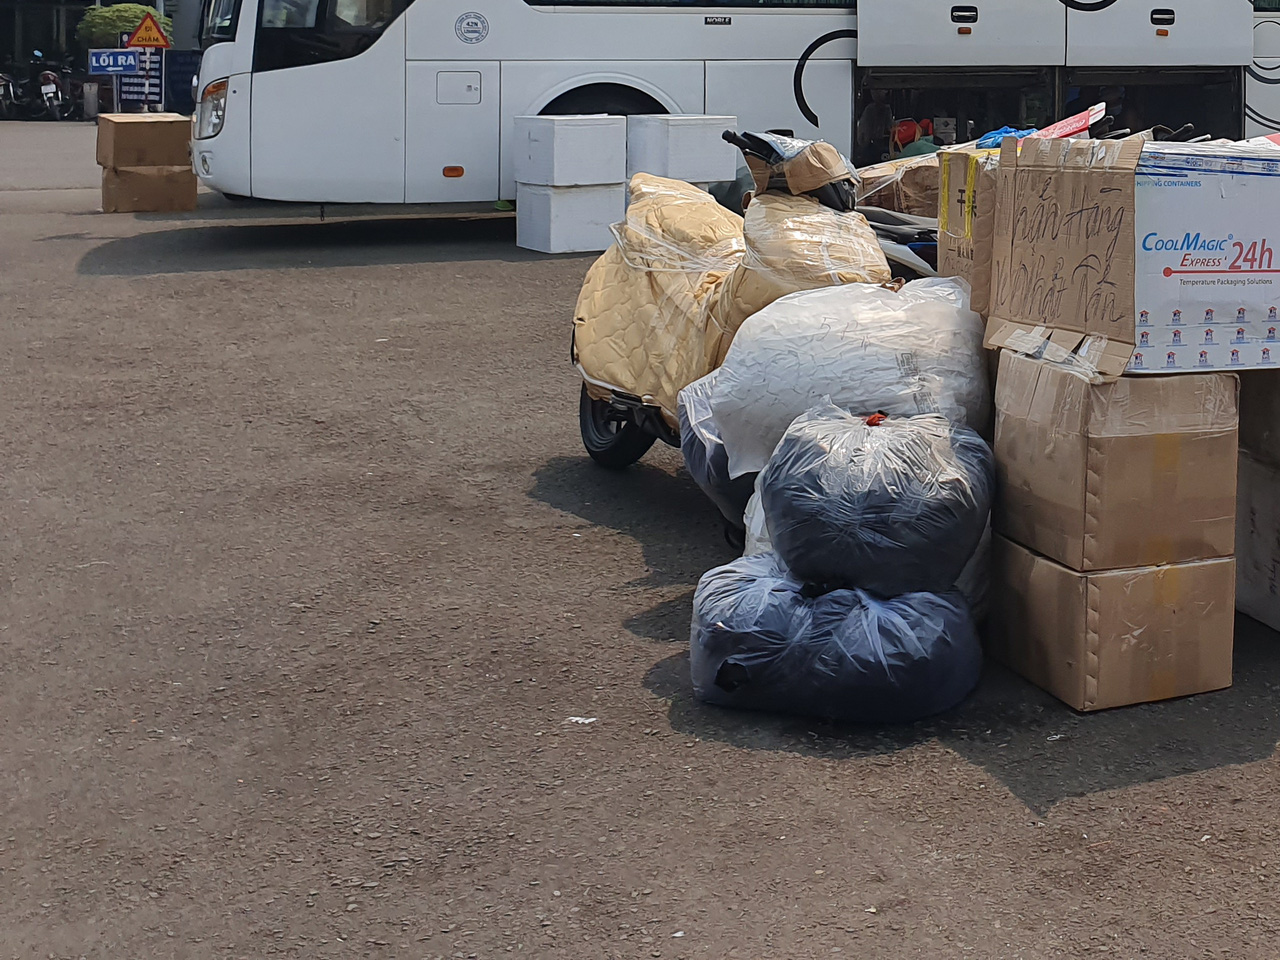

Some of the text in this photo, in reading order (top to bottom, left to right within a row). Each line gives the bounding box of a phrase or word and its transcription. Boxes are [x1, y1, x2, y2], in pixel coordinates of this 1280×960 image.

[91, 52, 113, 66] LỐI
[118, 55, 135, 66] RA
[1228, 239, 1273, 270] 24h
[1217, 278, 1246, 287] Packaging
